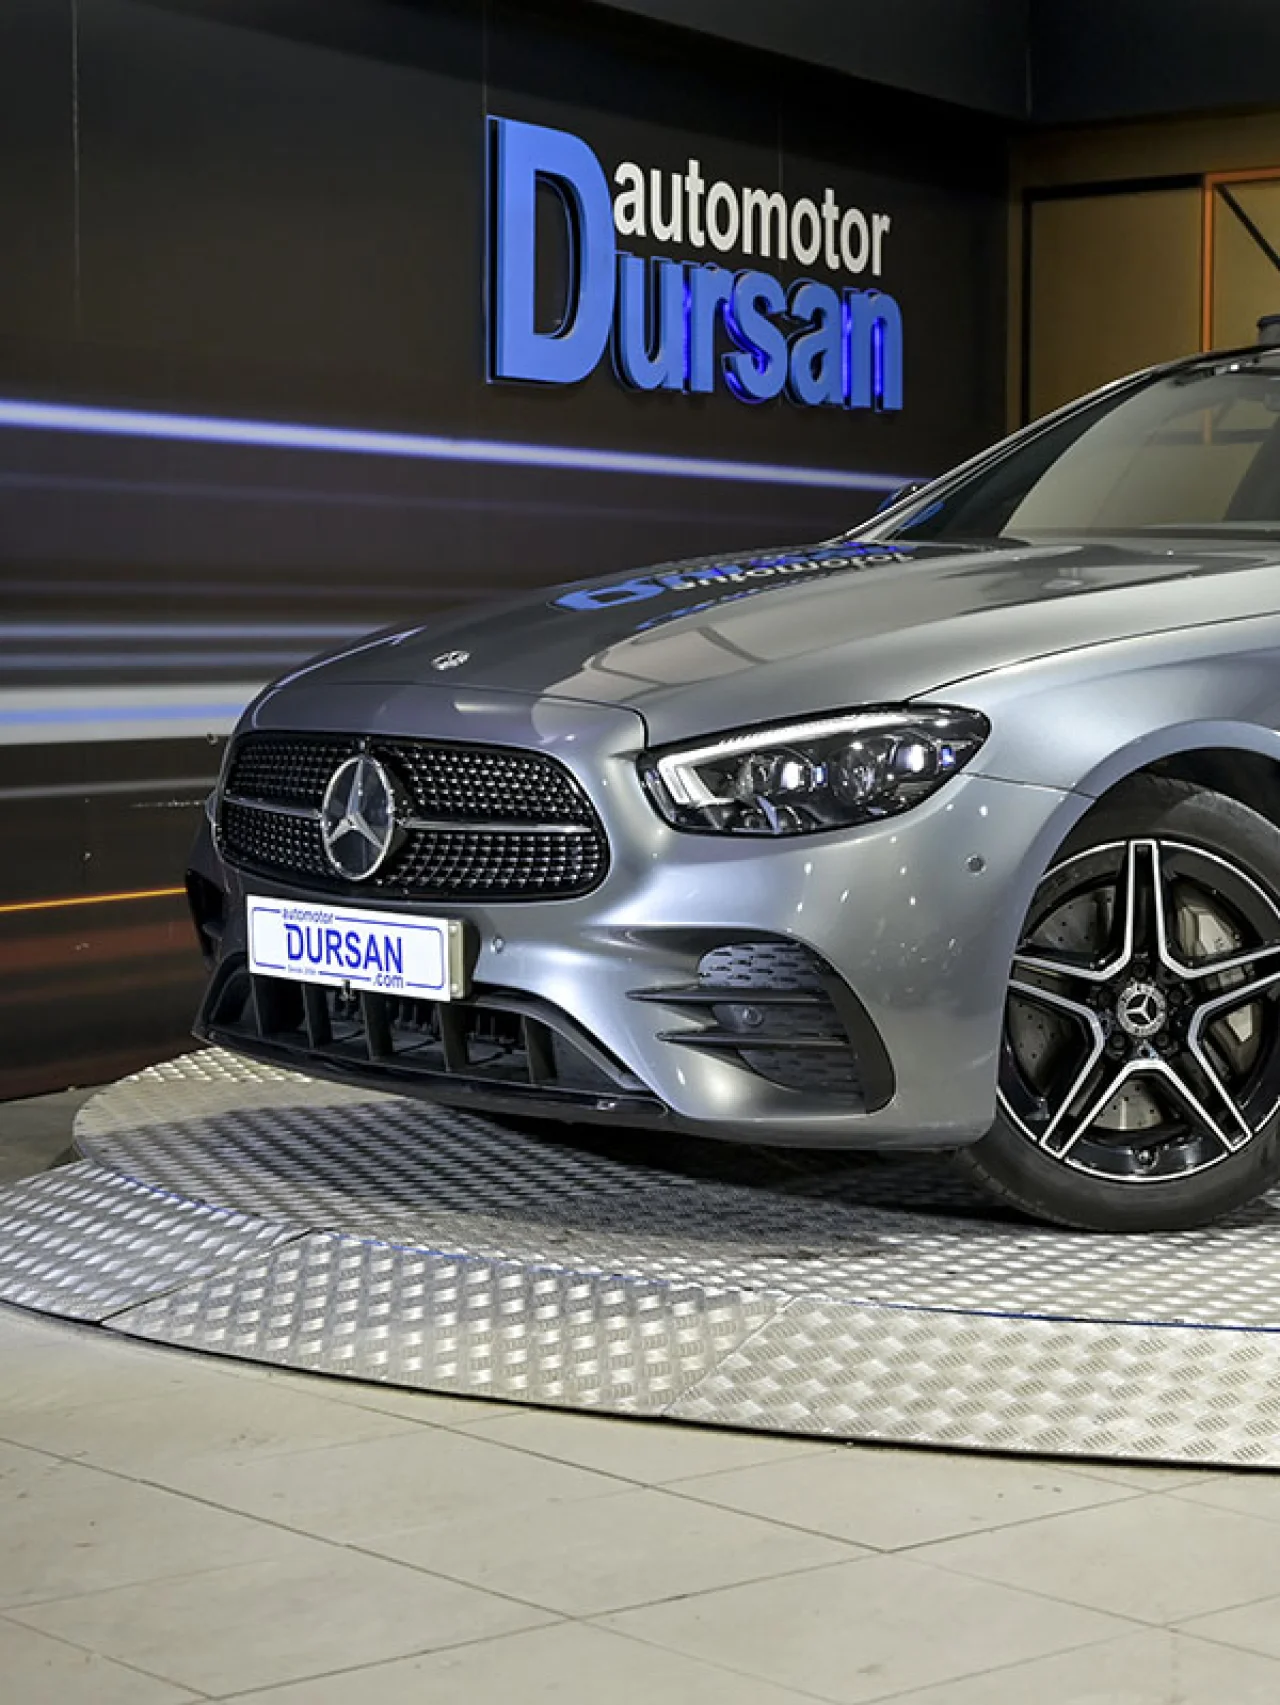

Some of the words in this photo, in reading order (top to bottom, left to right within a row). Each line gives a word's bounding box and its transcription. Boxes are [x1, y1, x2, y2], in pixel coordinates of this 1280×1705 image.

[613, 159, 891, 276] automotor
[486, 114, 903, 412] Dursan
[282, 907, 334, 924] automotor
[284, 923, 404, 973] DURSAN
[373, 972, 404, 988] .com
